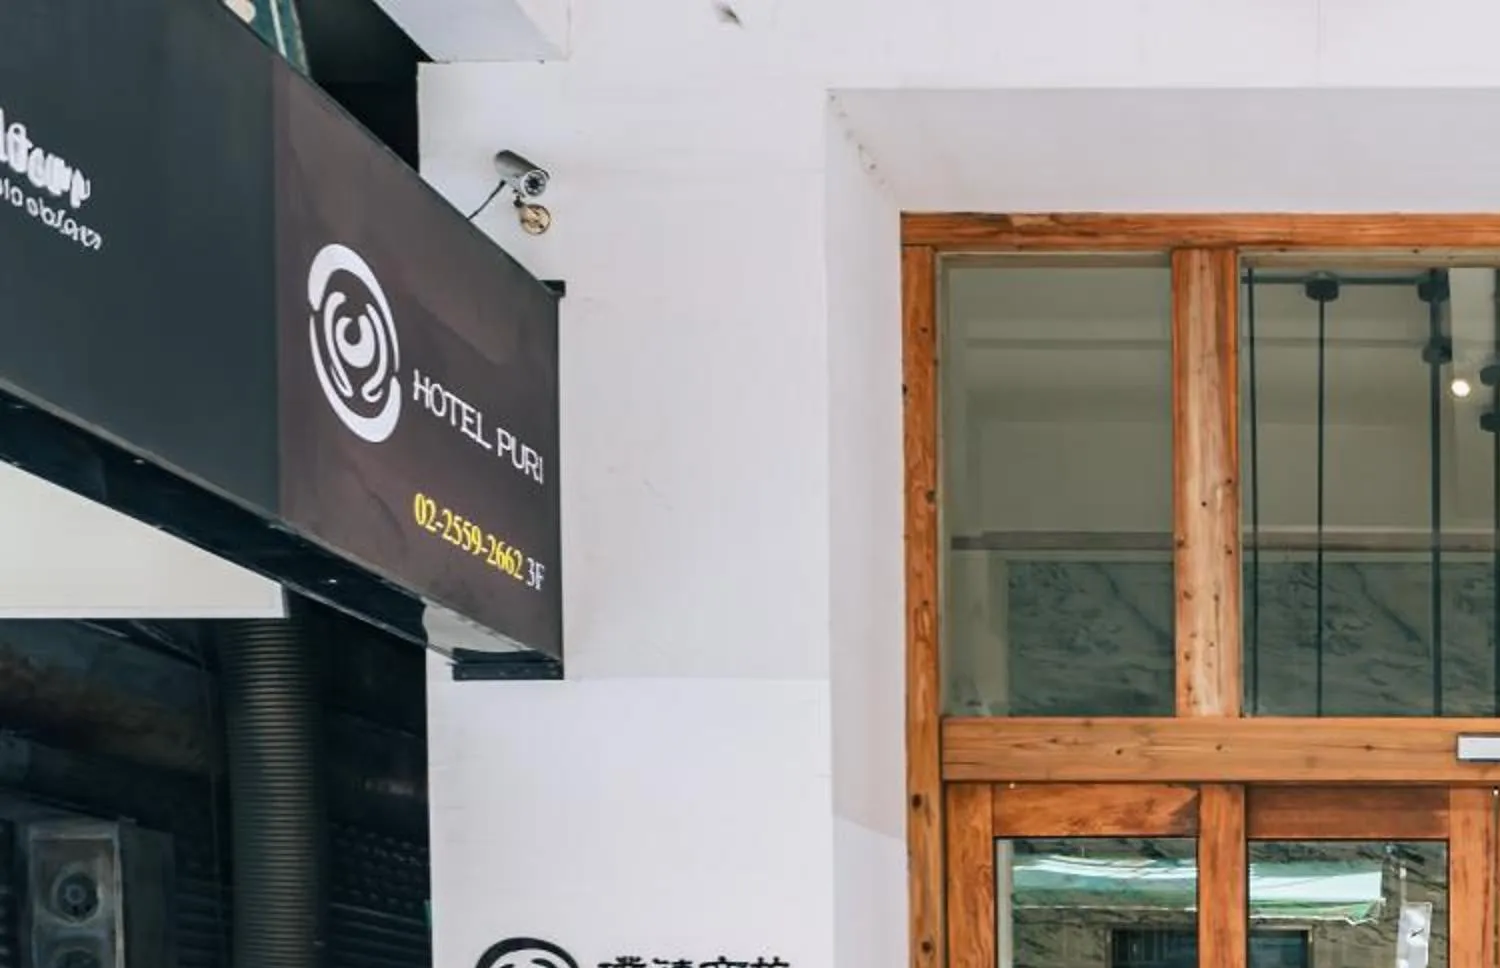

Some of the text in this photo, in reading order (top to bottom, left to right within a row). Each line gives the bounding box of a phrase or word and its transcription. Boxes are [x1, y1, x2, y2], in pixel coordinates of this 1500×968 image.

[413, 368, 544, 484] HOTEL PURI
[414, 493, 545, 590] 02-2559-2662 3F
